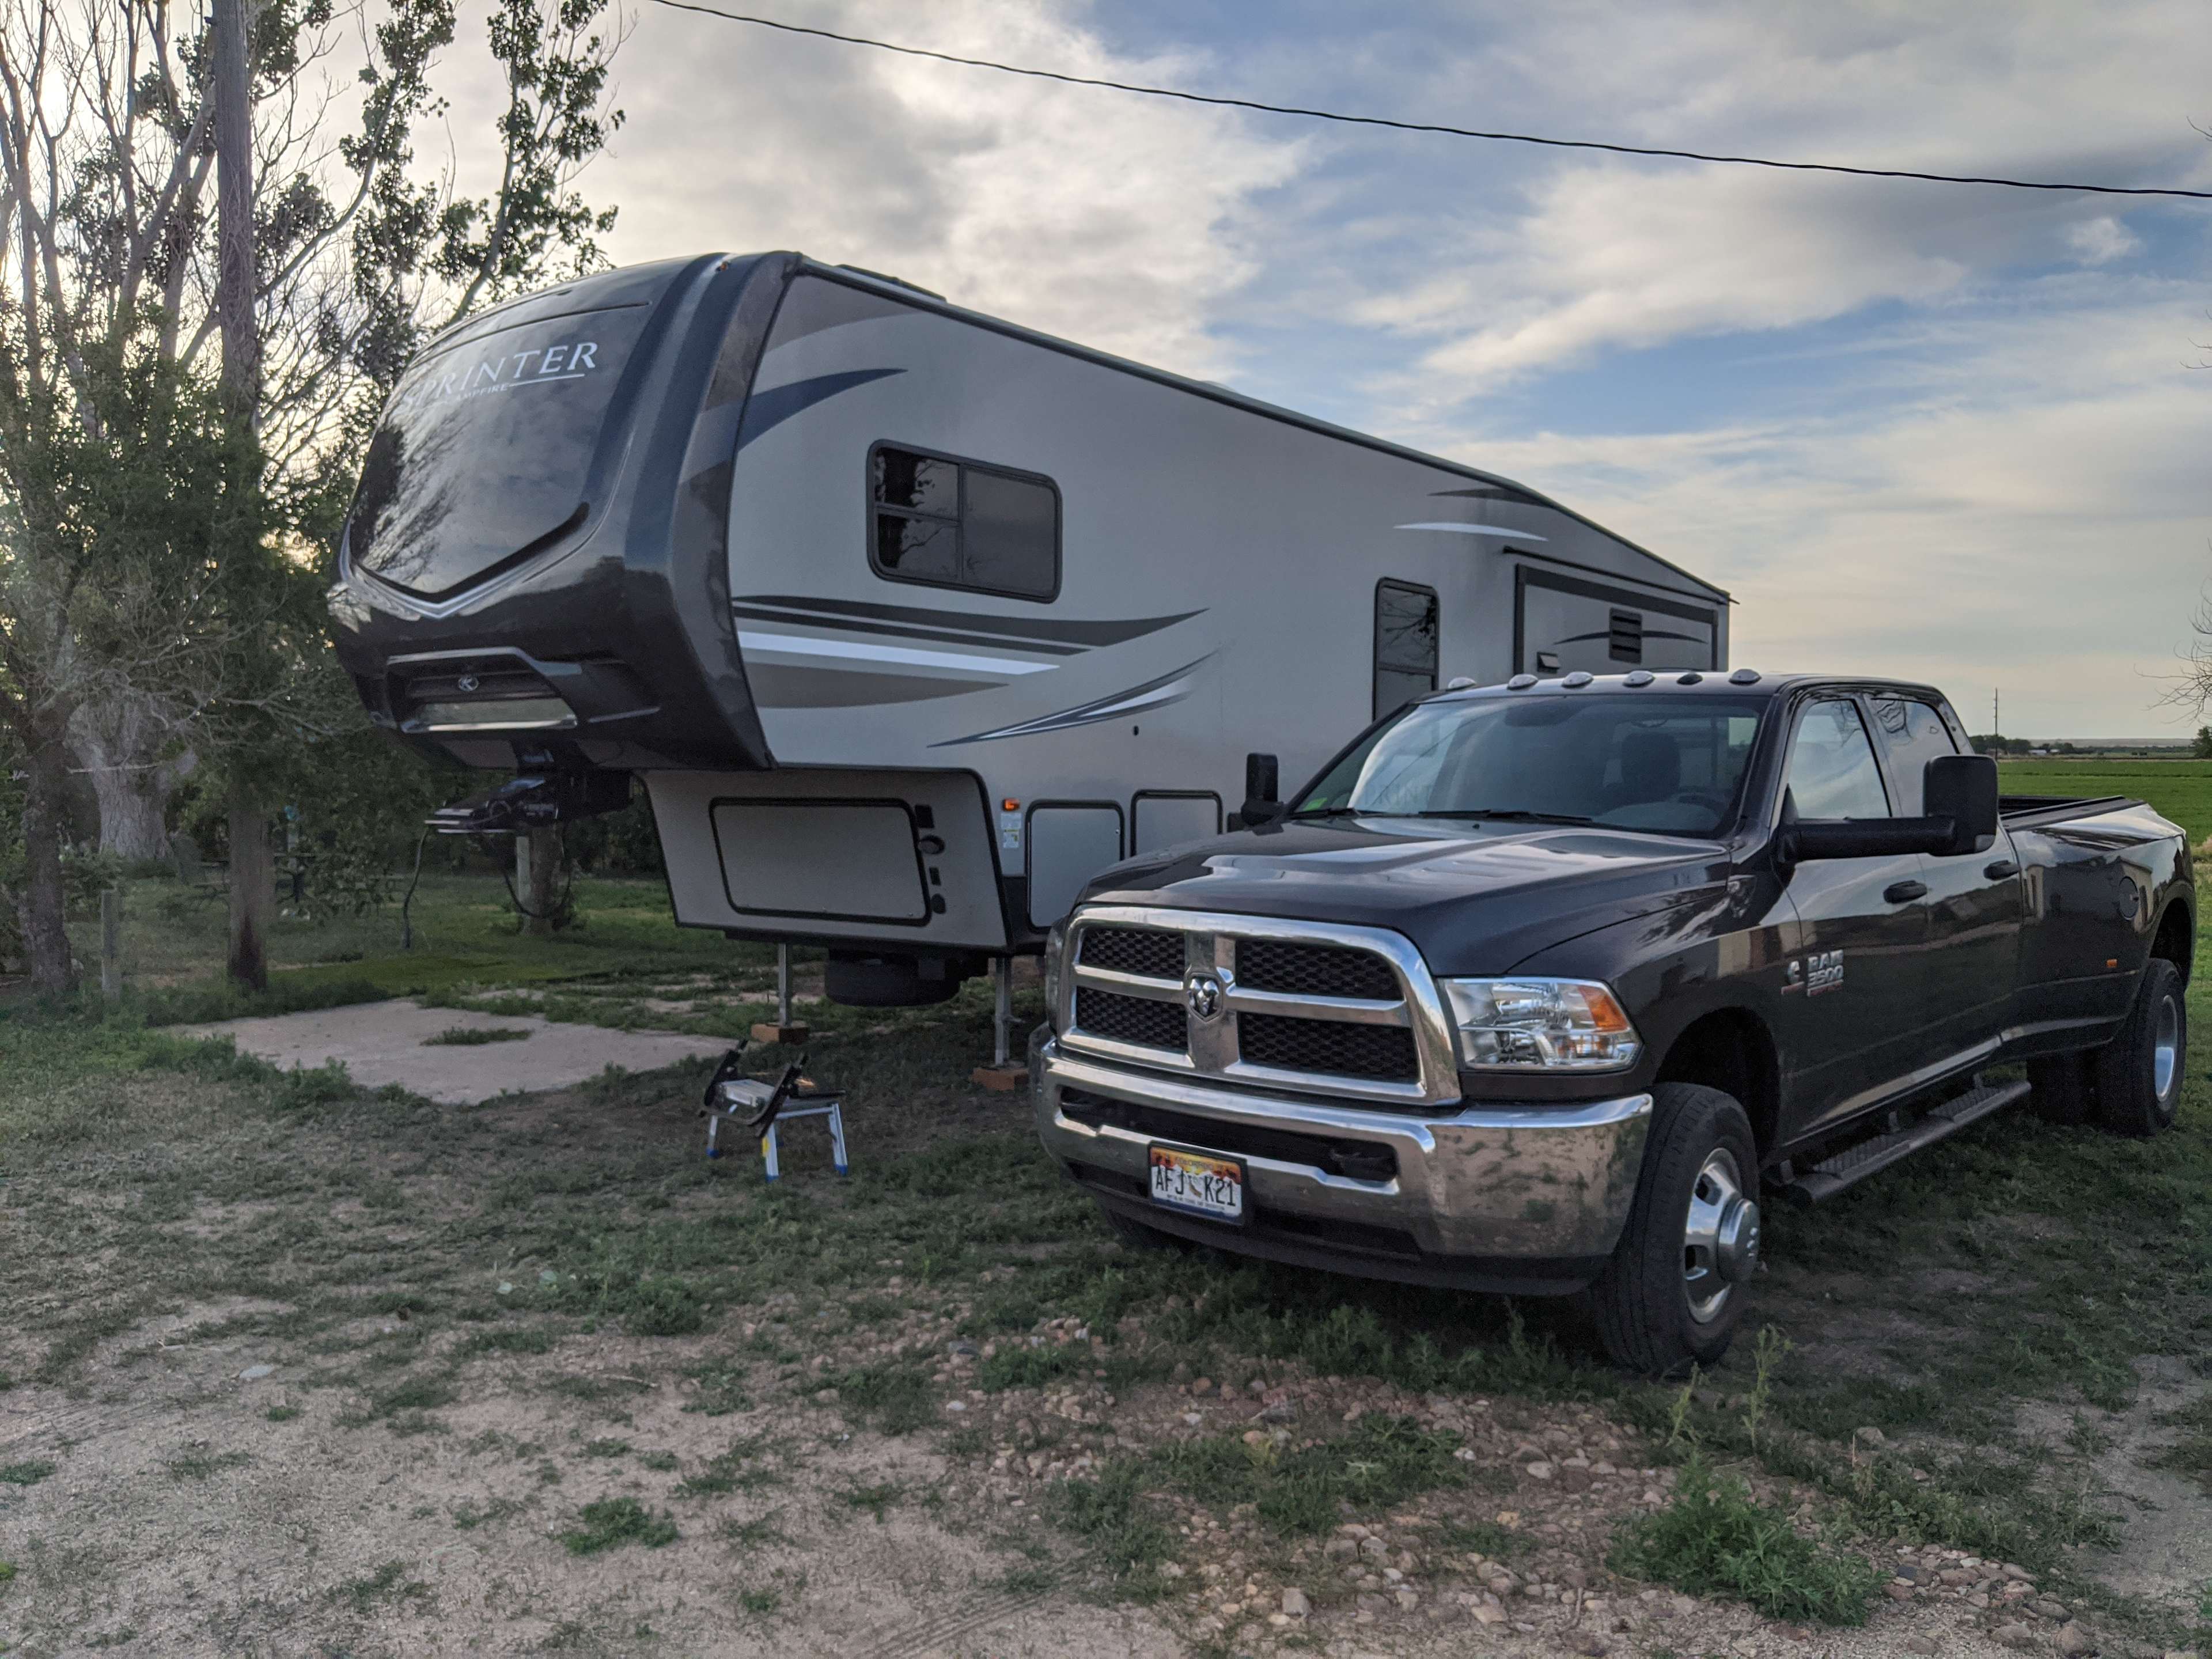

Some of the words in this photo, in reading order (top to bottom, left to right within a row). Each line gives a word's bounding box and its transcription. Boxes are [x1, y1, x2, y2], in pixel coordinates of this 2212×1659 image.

[401, 342, 598, 410] SPRINTER
[449, 382, 509, 403] AMPFIRE
[1808, 965, 1843, 987] 3500
[1156, 1166, 1184, 1195] AFJ
[1205, 1175, 1236, 1207] K21
